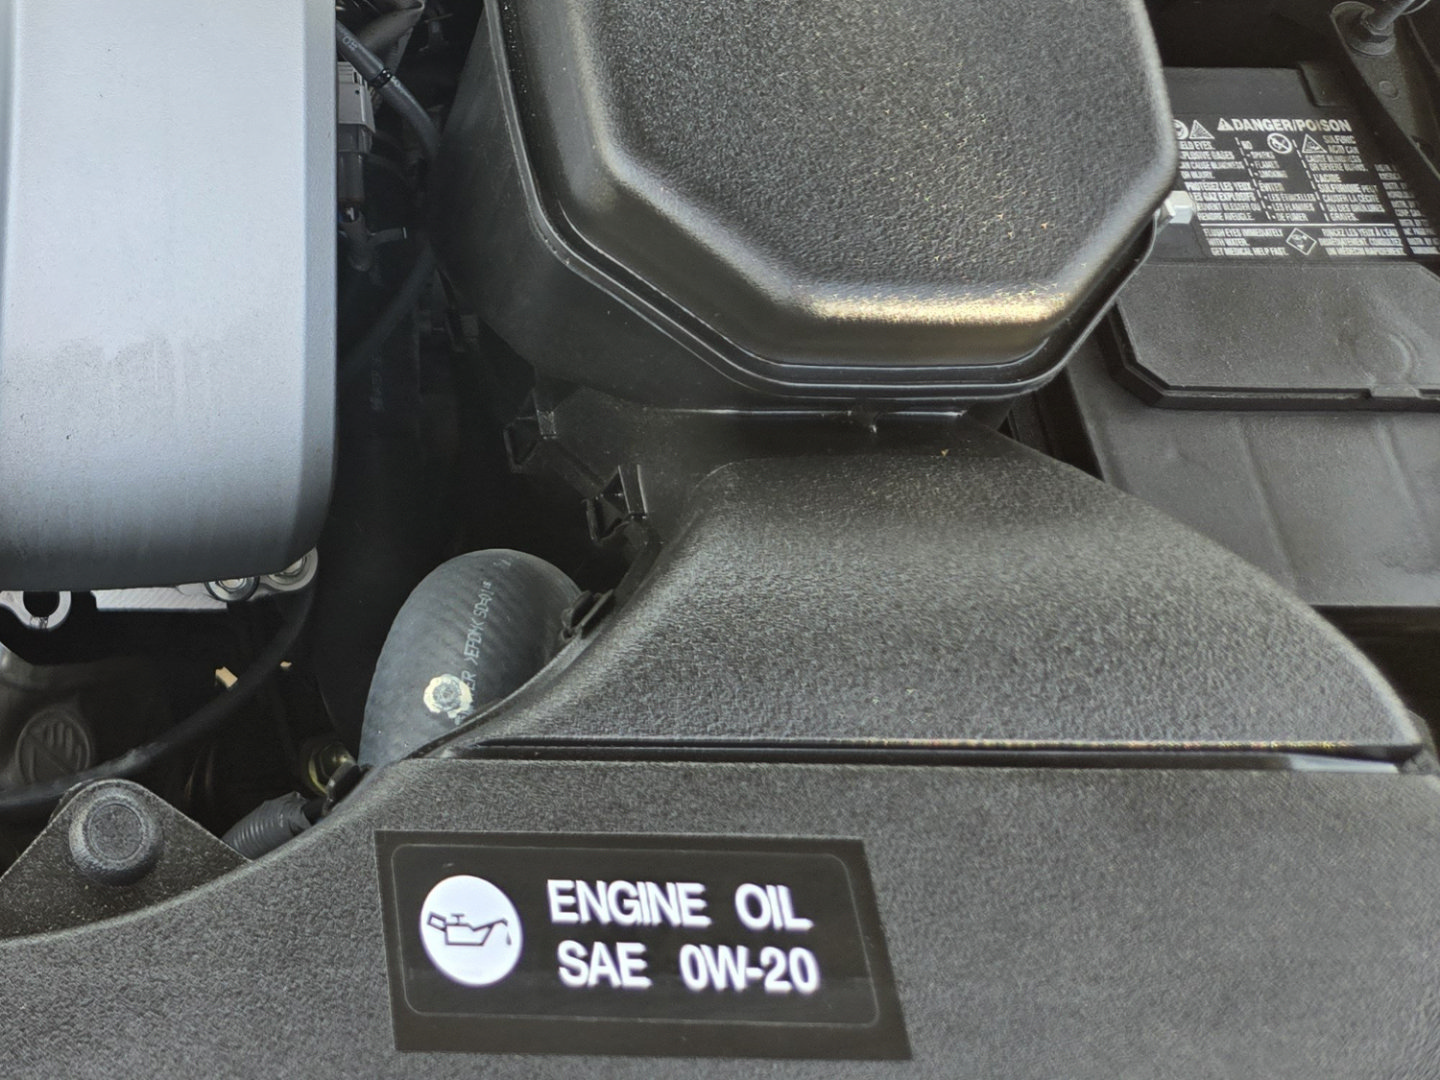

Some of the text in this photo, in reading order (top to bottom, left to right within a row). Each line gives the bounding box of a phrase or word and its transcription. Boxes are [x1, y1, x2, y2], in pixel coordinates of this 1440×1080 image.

[1231, 118, 1353, 132] DANGER/POISON
[547, 879, 814, 931] ENGINE OIL
[558, 939, 821, 995] SAE 0W-20
